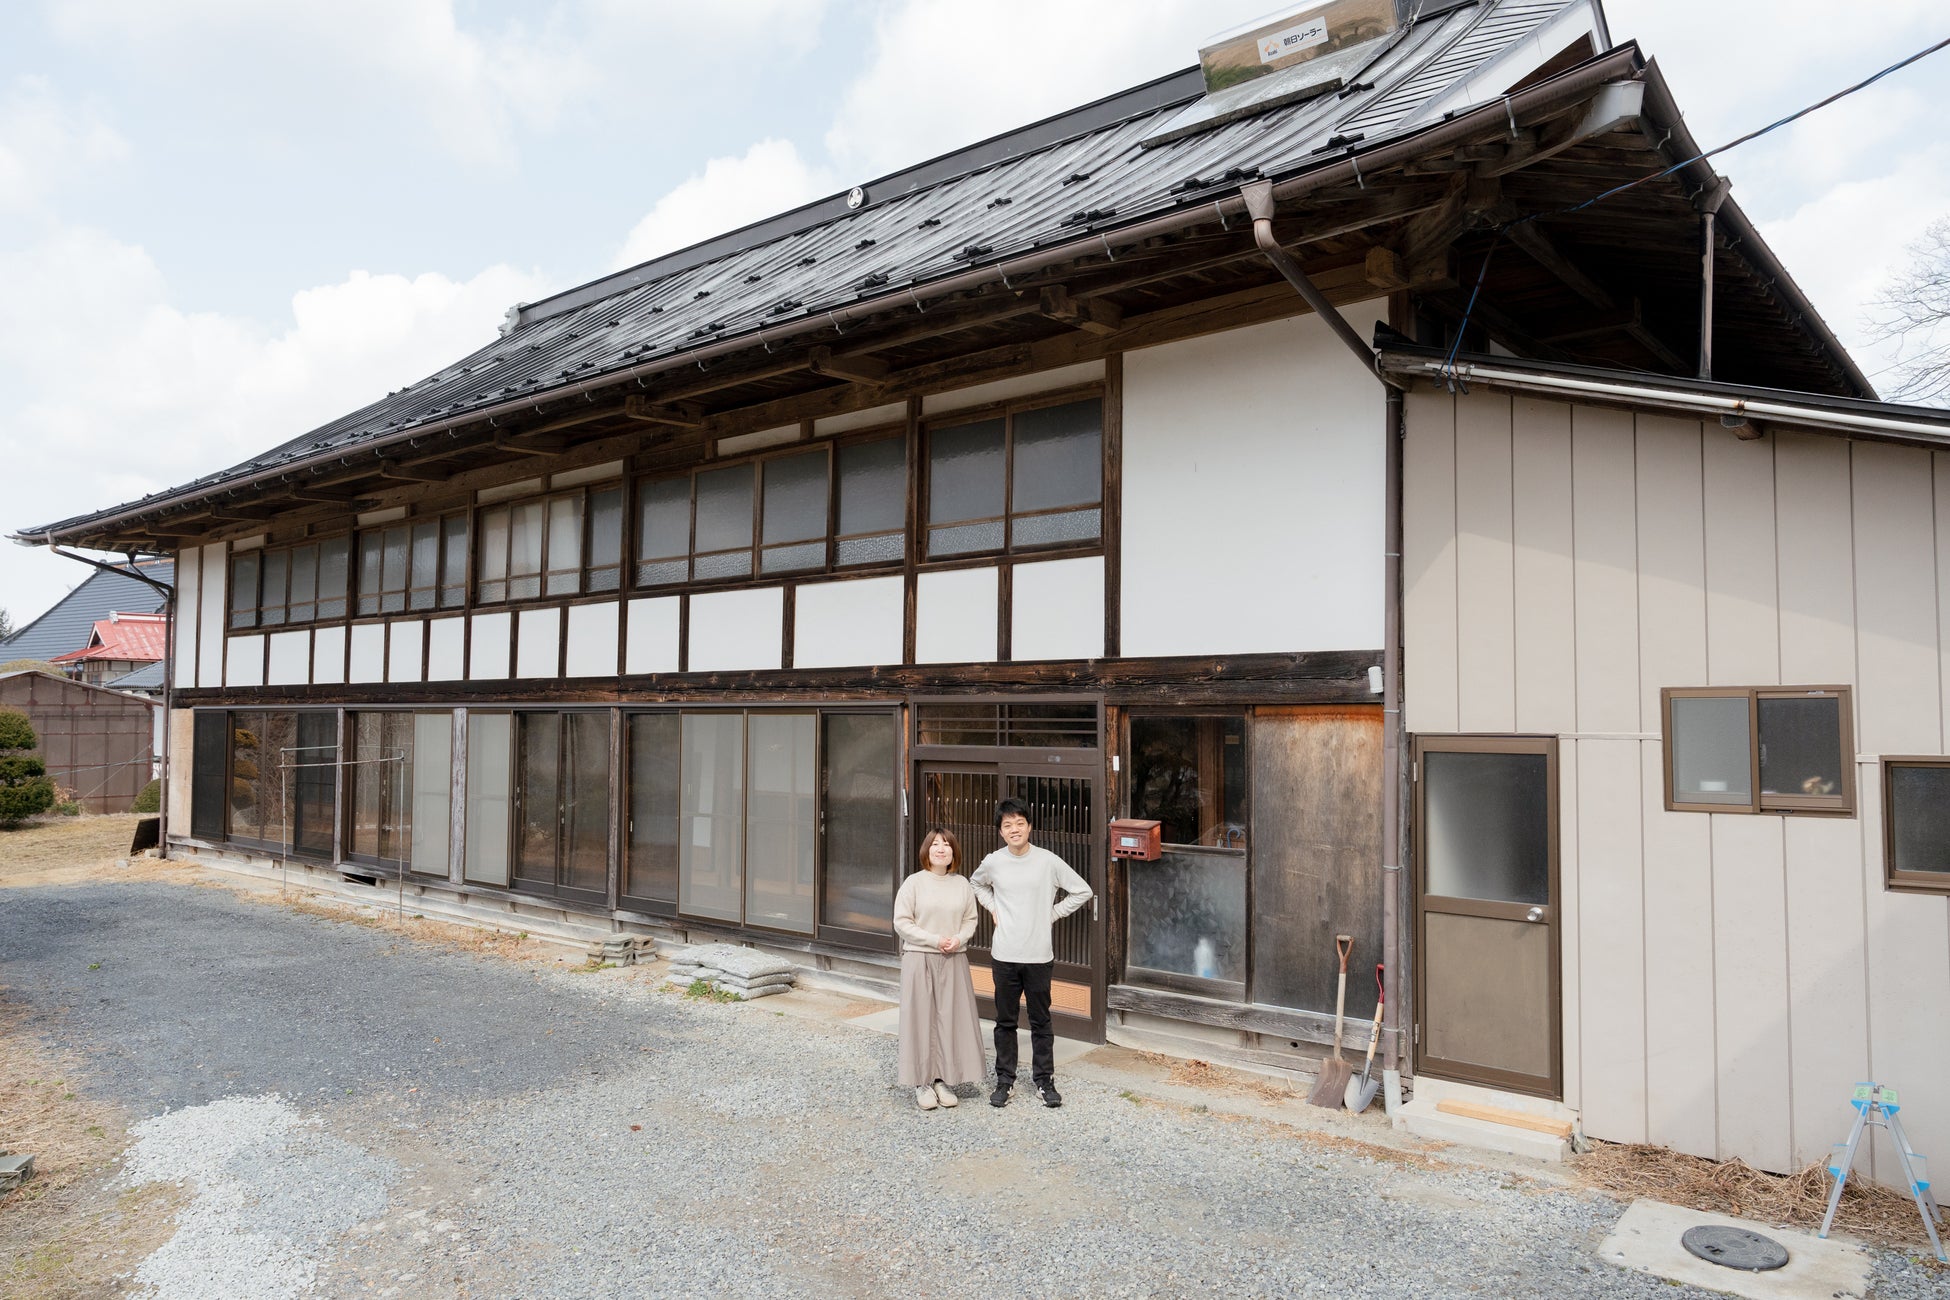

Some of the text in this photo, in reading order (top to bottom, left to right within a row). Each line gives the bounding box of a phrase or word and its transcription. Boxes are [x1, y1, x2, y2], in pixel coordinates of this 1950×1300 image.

[1283, 28, 1322, 46] 朝日ソーラー
